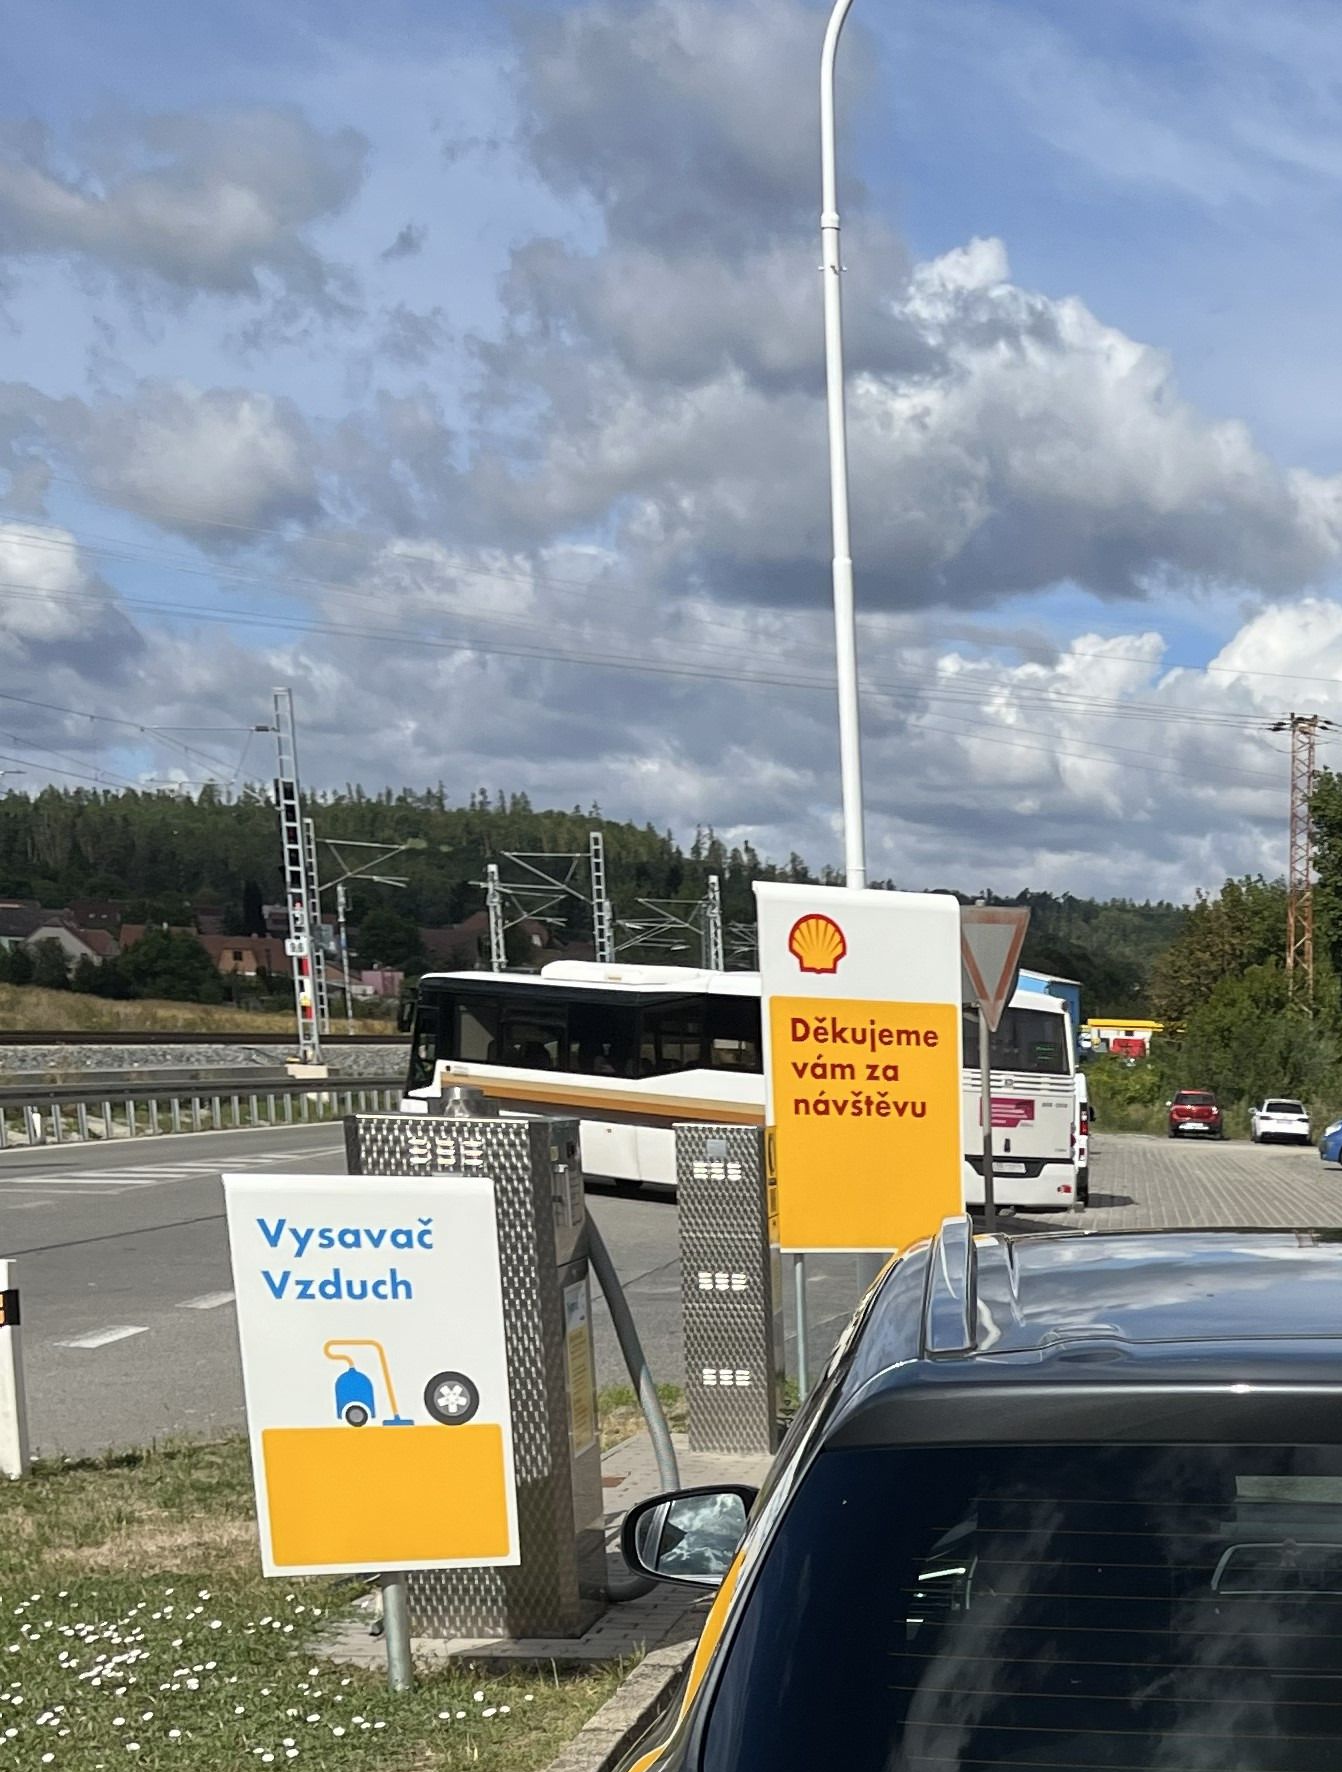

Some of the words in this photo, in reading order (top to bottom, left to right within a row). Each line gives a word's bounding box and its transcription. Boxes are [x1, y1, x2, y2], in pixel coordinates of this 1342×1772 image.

[791, 1016, 939, 1052] Děkujeme
[791, 1053, 856, 1080] vám
[865, 1064, 899, 1081] za
[794, 1090, 927, 1118] návštěvu
[256, 1217, 433, 1258] Vysavač
[261, 1268, 413, 1299] Vzduch
